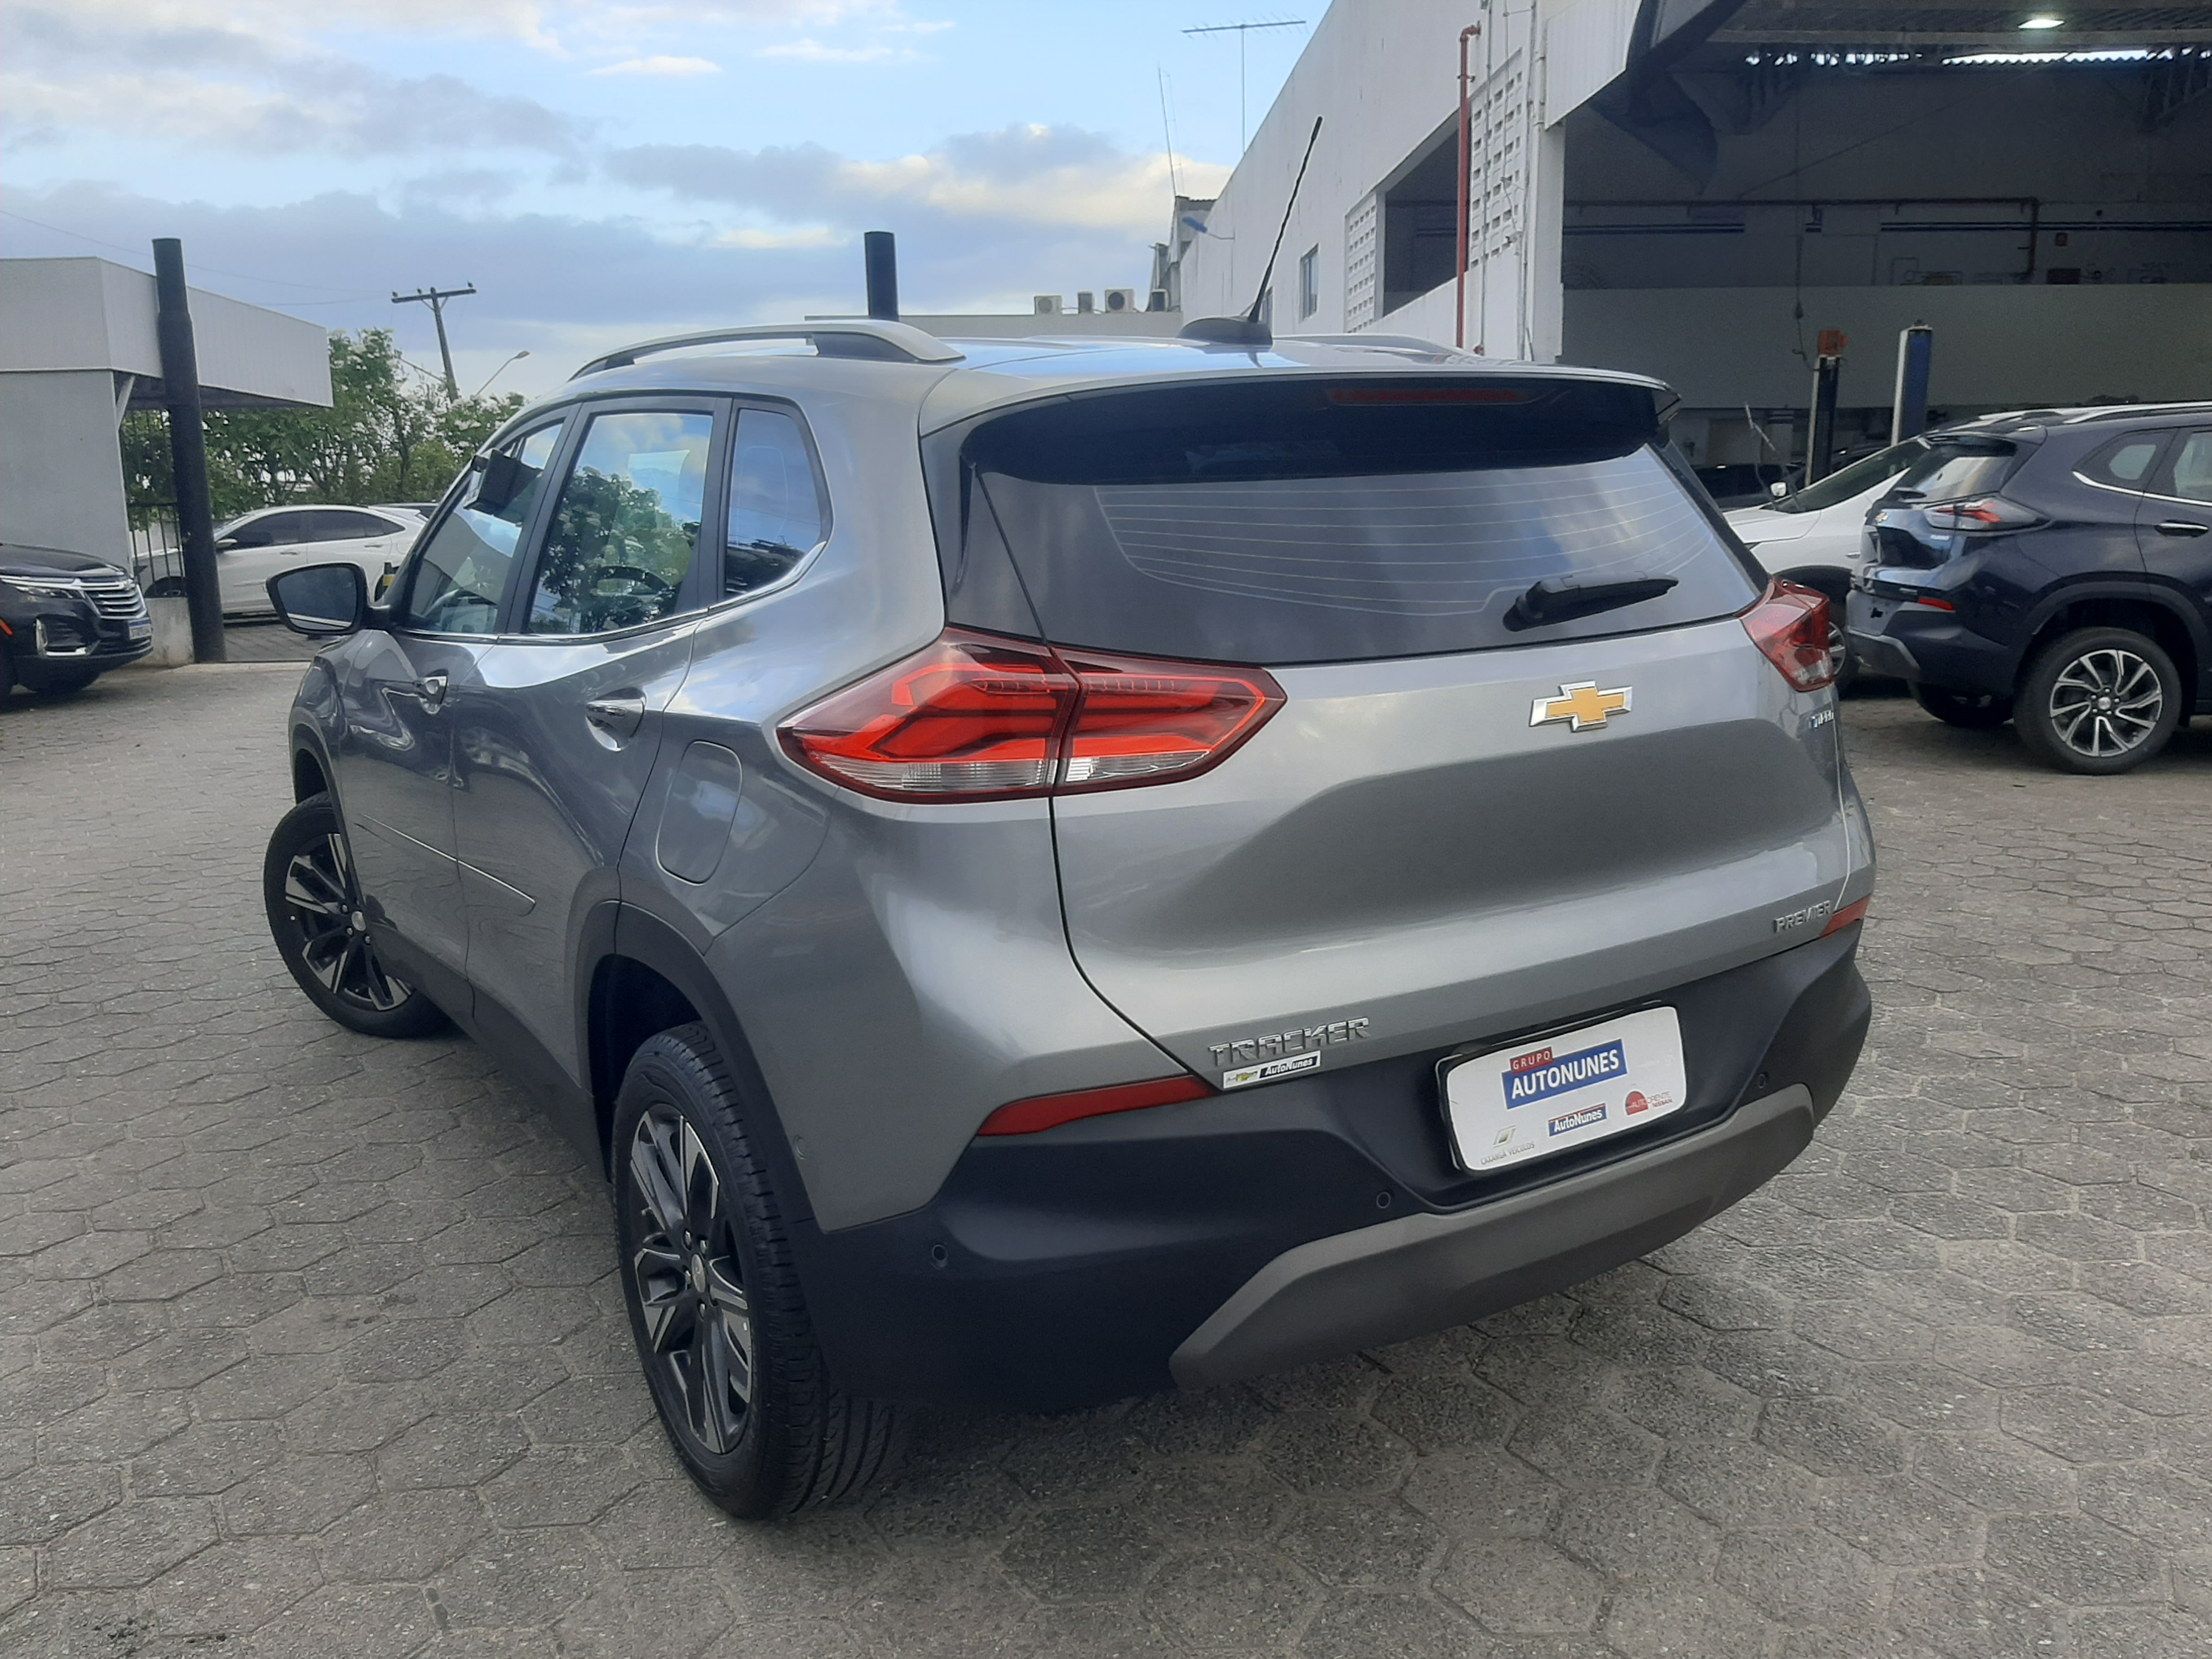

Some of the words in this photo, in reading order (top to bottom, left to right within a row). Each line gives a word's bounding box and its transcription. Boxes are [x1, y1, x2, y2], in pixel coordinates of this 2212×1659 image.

[1773, 900, 1832, 933] PREMIER
[1208, 1017, 1371, 1066] TRACKER
[1266, 1058, 1313, 1076] AutoNunes
[1512, 1050, 1551, 1070] GRUPO
[1511, 1049, 1619, 1100] AUTONUNES
[1553, 1109, 1603, 1133] AutoNunes
